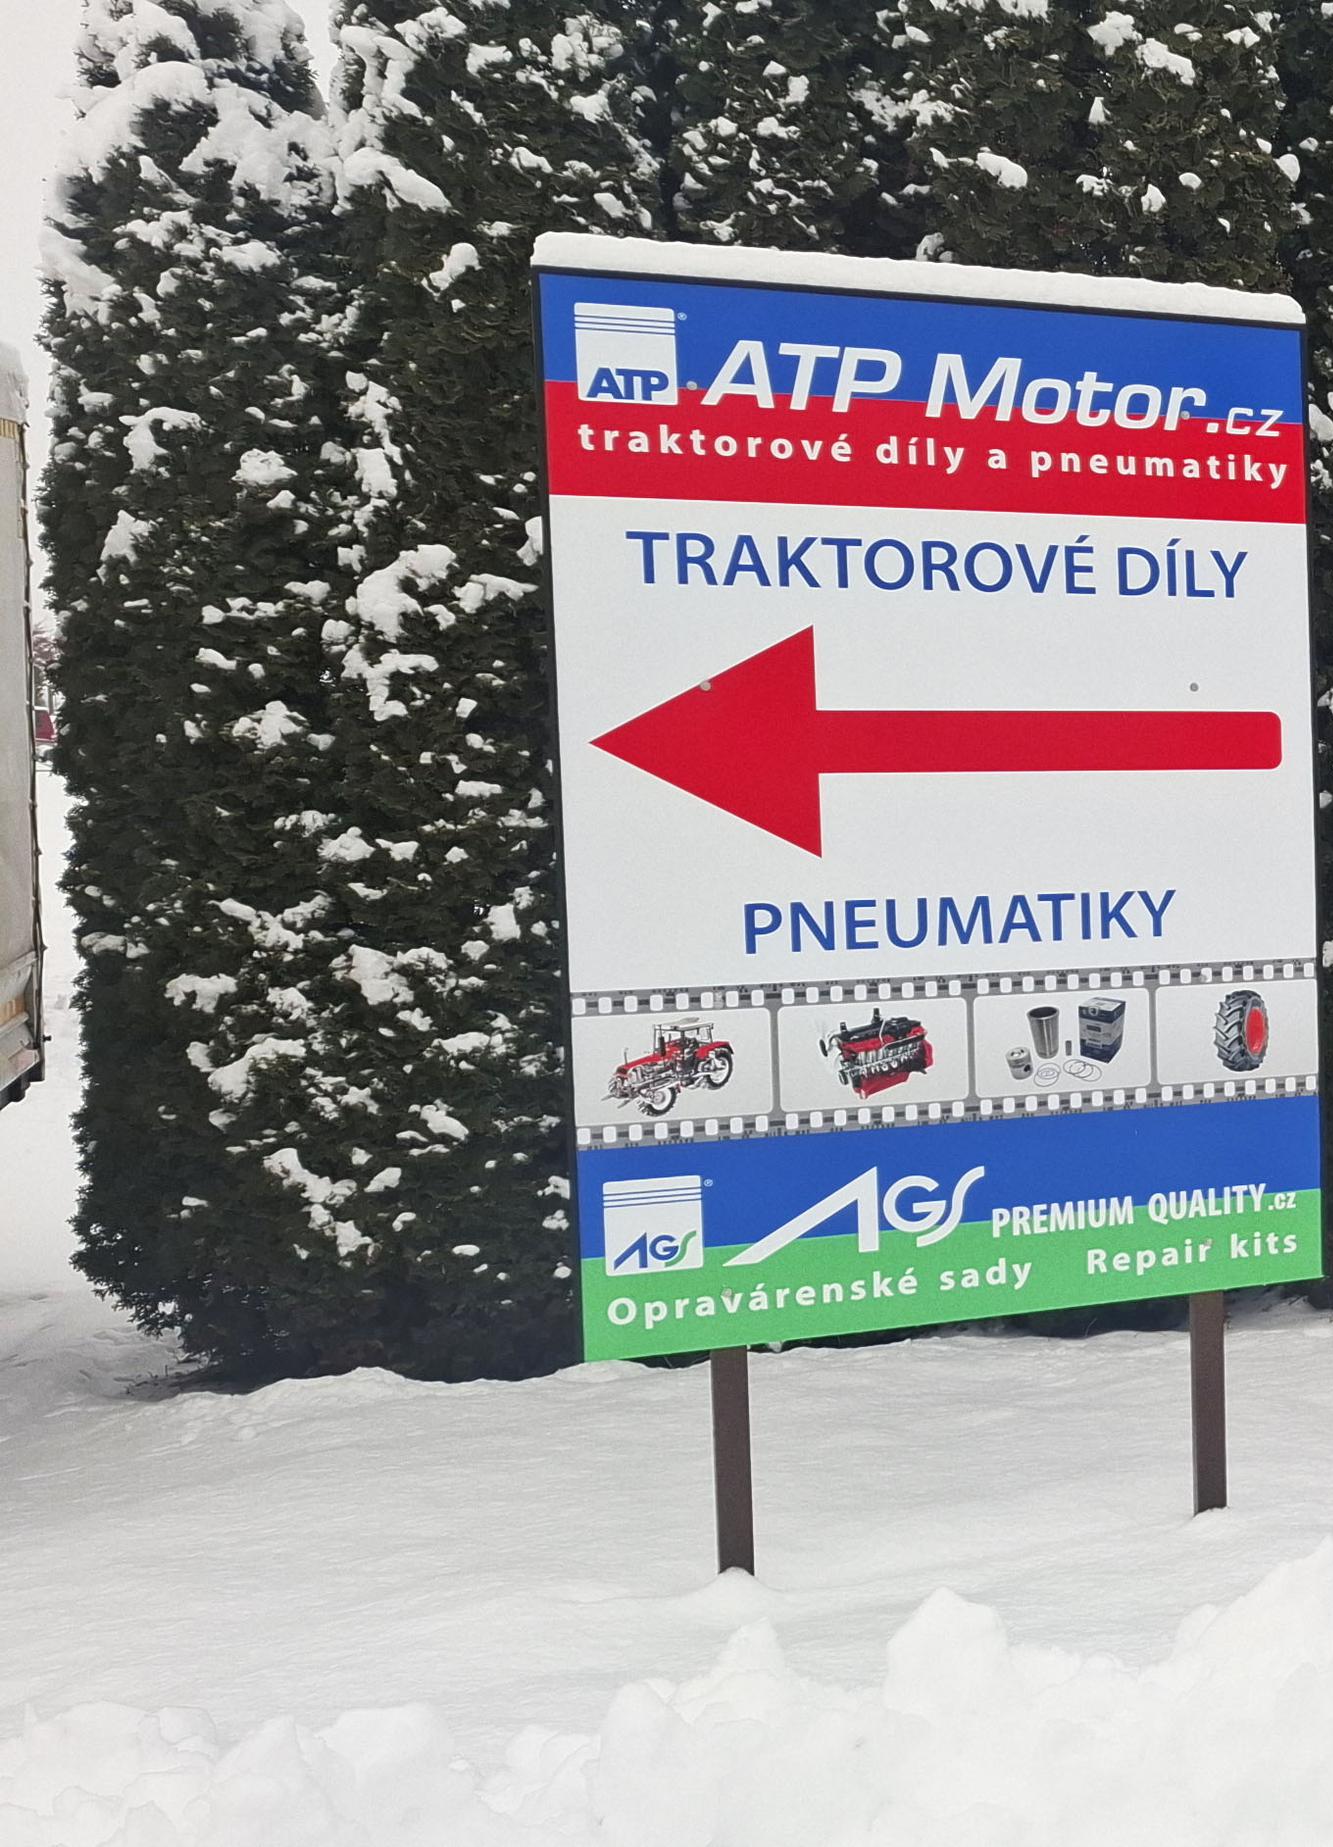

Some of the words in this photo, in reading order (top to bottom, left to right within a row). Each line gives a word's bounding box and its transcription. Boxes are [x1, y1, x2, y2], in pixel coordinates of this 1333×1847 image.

[586, 367, 669, 401] ATP
[700, 339, 903, 413] ATP
[577, 424, 852, 464] traktorové
[875, 434, 965, 475] díly
[987, 448, 1008, 469] a
[1030, 450, 1288, 490] pneumatiky
[625, 530, 1097, 595] TRAKTOROVÉ
[1117, 536, 1248, 598] DÍLY
[743, 889, 1177, 955] PNEUMATIKY
[721, 1165, 986, 1268] AGS
[990, 1194, 1135, 1239] PREMIUM
[613, 1230, 697, 1271] AGS
[1086, 1236, 1216, 1277] Repair
[1229, 1230, 1300, 1260] kits
[606, 1268, 919, 1330] Opravárenské
[938, 1256, 1033, 1291] sady
